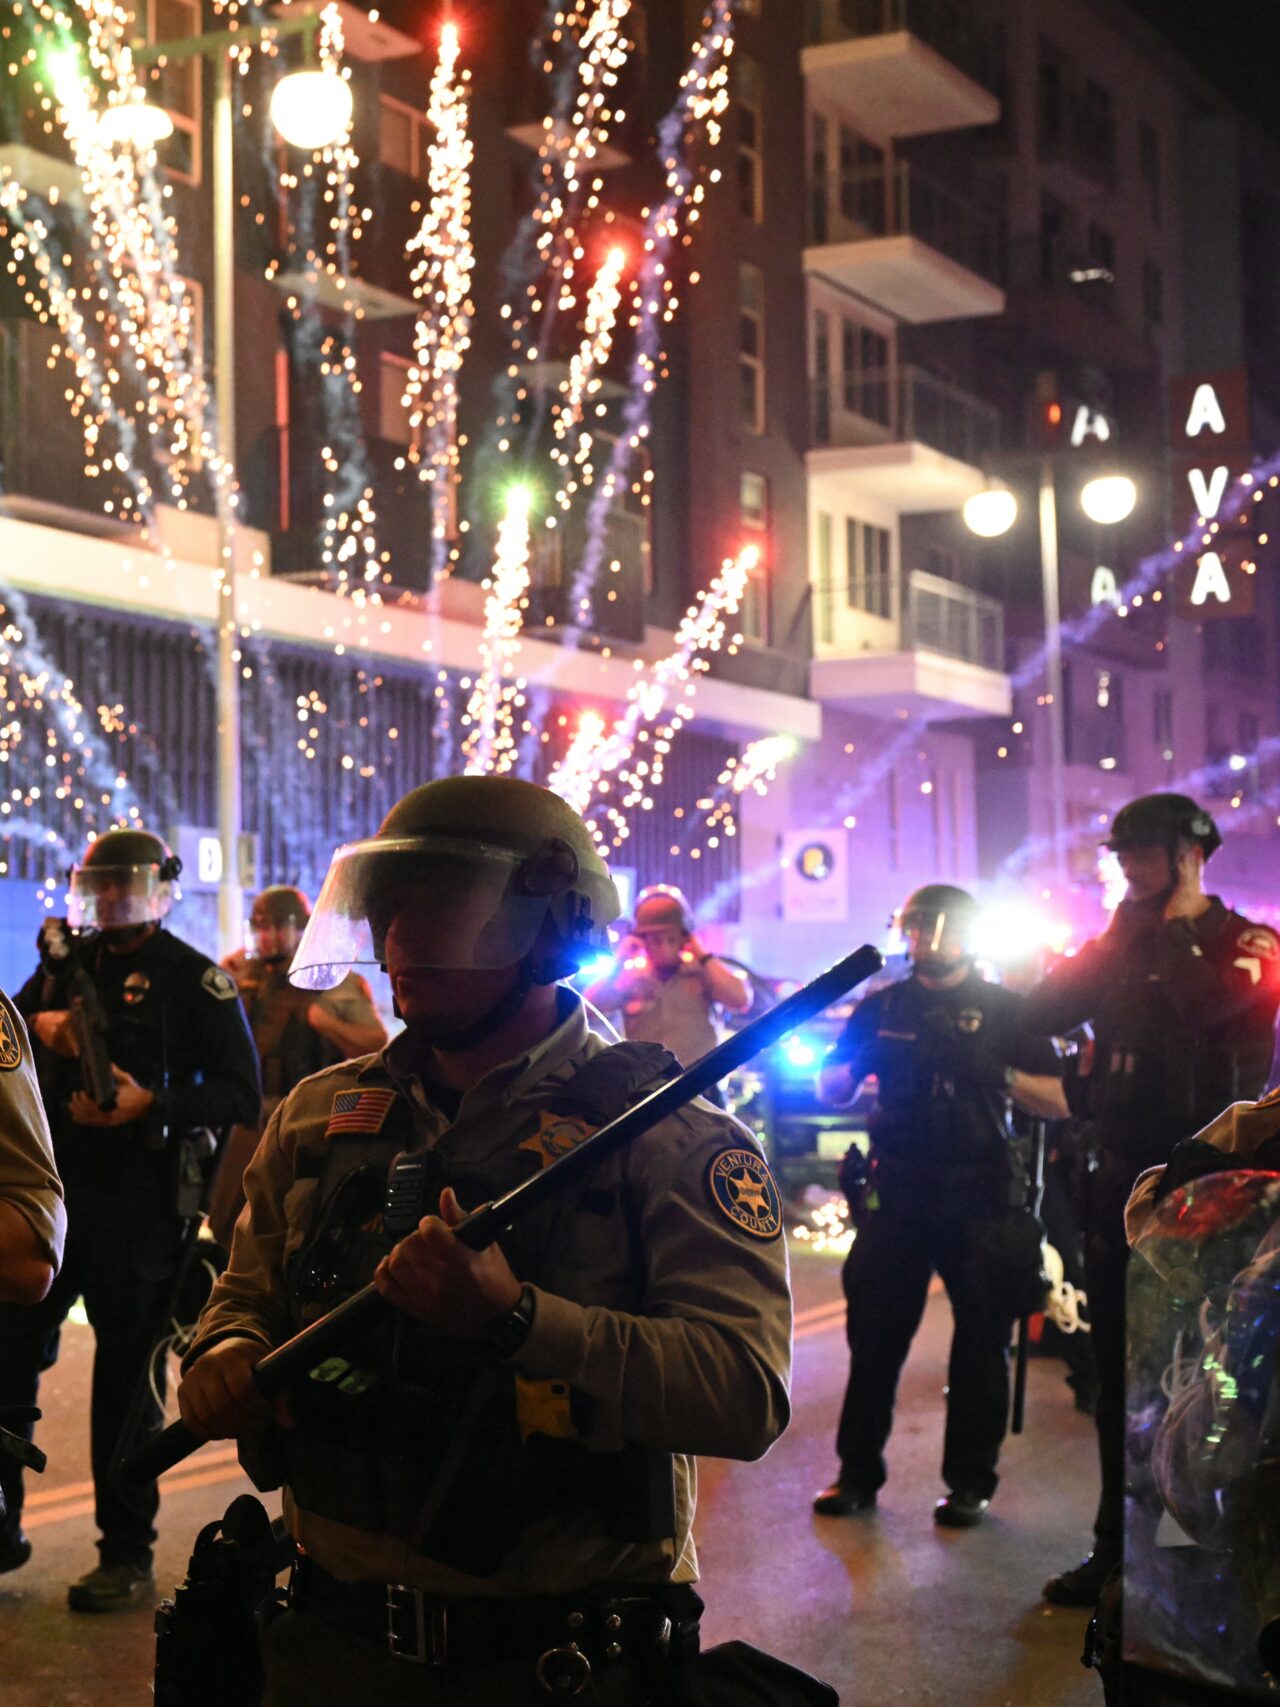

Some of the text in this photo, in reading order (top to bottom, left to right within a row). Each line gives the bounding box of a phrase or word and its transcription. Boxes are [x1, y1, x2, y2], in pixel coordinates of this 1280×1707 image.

[1186, 383, 1231, 606] AVA
[715, 1152, 770, 1183] VENTURA
[730, 1205, 778, 1233] COUNTY
